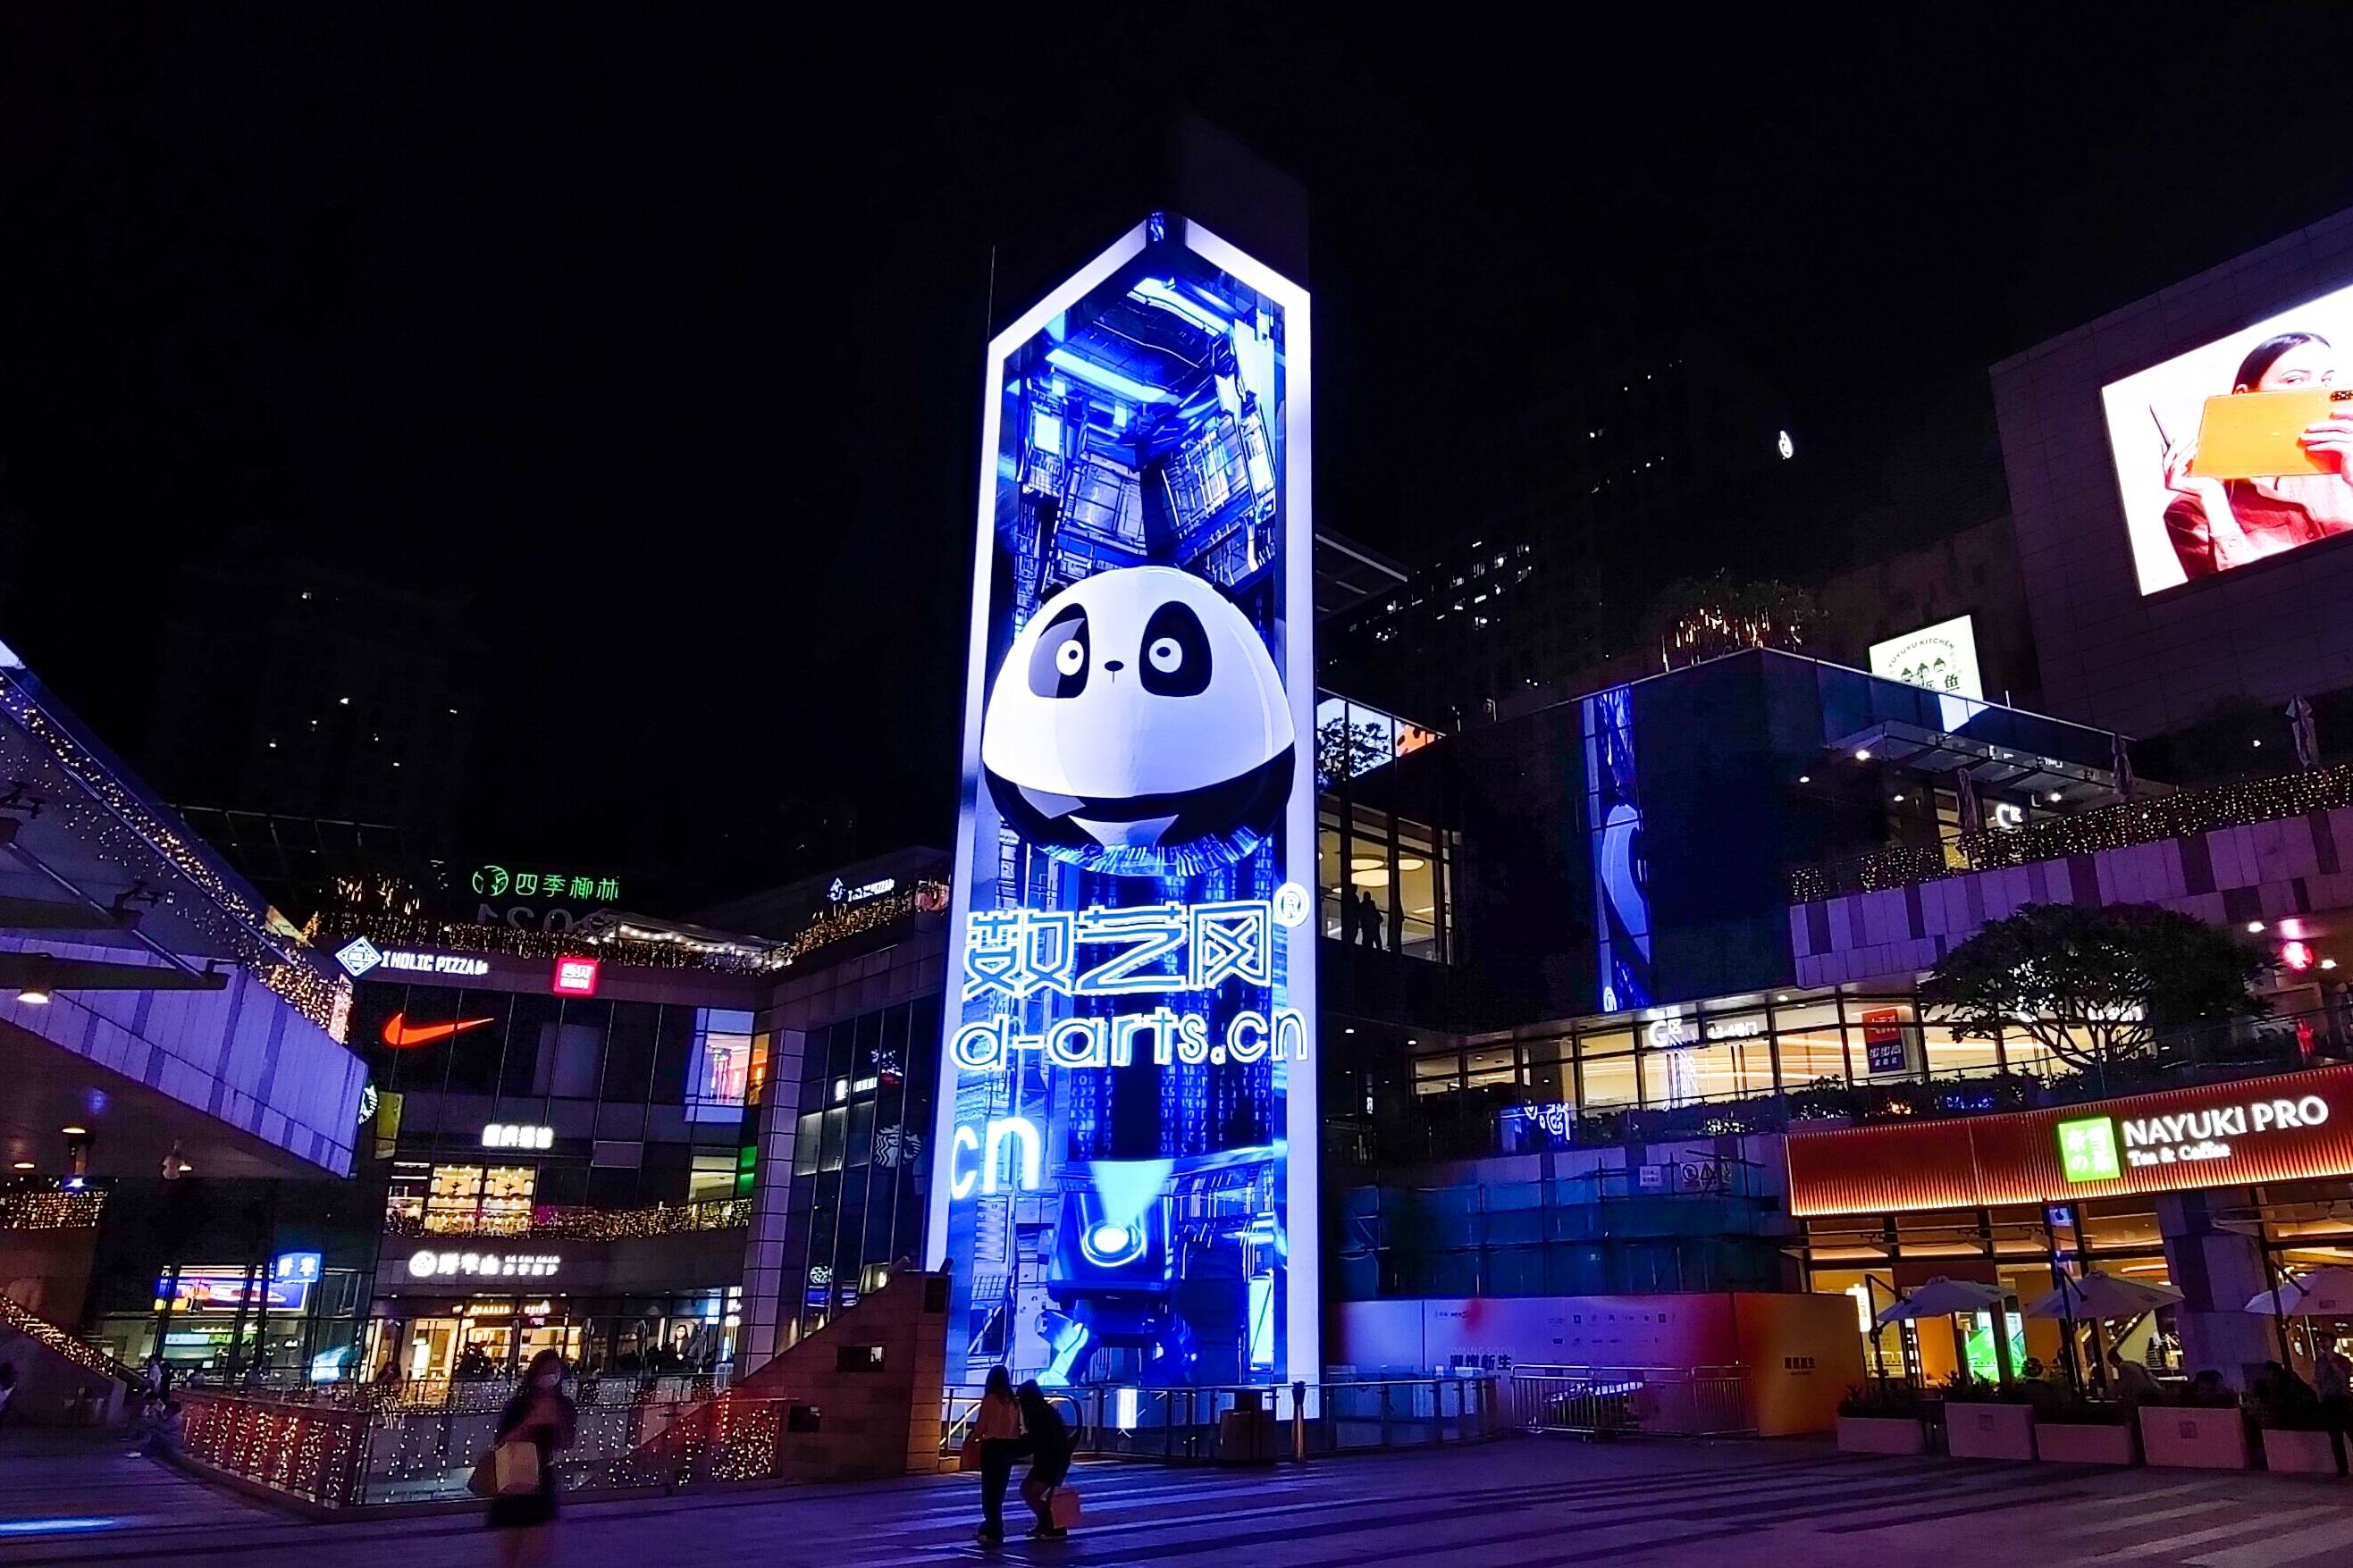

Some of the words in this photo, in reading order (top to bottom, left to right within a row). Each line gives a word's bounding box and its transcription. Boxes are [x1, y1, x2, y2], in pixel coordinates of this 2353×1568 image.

[515, 873, 620, 901] 四季椰林
[391, 952, 434, 972] HOLIC
[435, 955, 475, 976] PIZZA
[949, 1006, 1309, 1071] d-arts.cn
[2122, 1106, 2248, 1147] NAYUKI
[2252, 1095, 2329, 1132] PRO
[2127, 1150, 2159, 1167] Tea
[2179, 1140, 2231, 1161] Coffee
